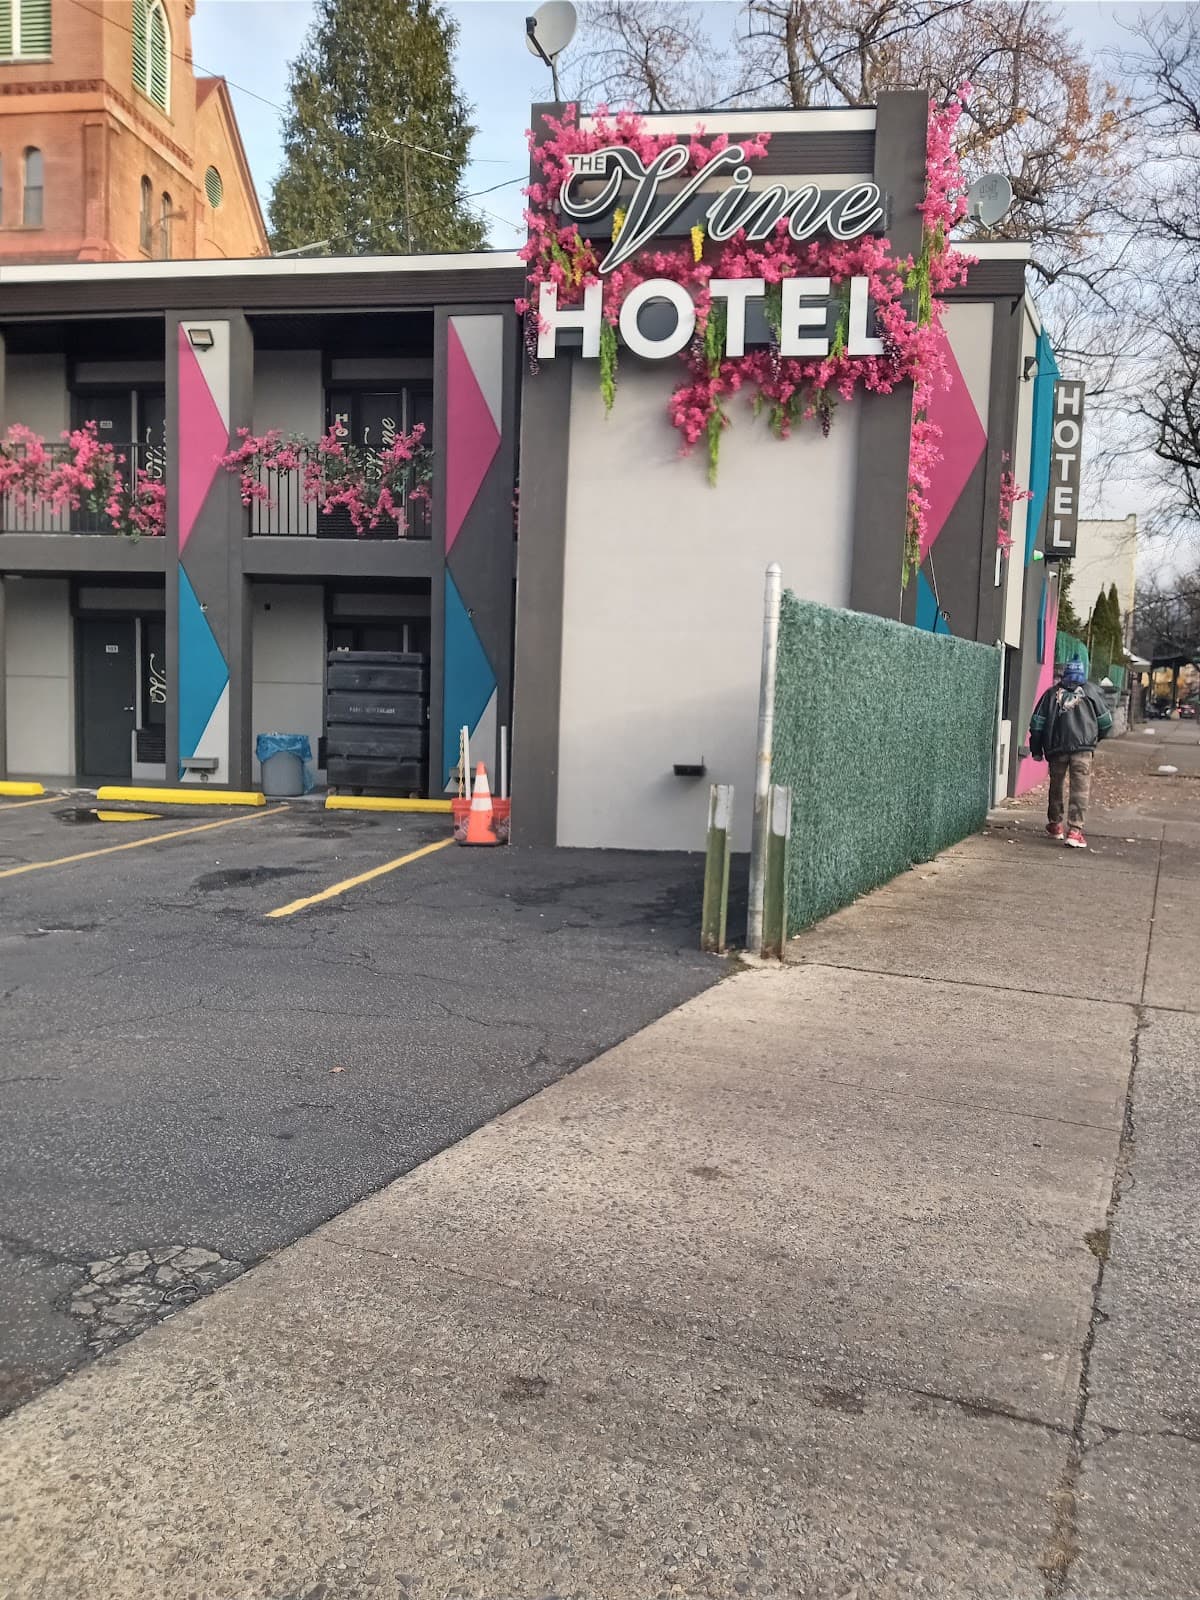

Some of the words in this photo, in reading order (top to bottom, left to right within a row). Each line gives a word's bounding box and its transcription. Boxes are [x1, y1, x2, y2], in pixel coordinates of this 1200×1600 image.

[560, 145, 882, 274] Vine
[570, 156, 605, 171] THE
[537, 278, 886, 359] HOTEL
[1054, 387, 1081, 548] HOTEL
